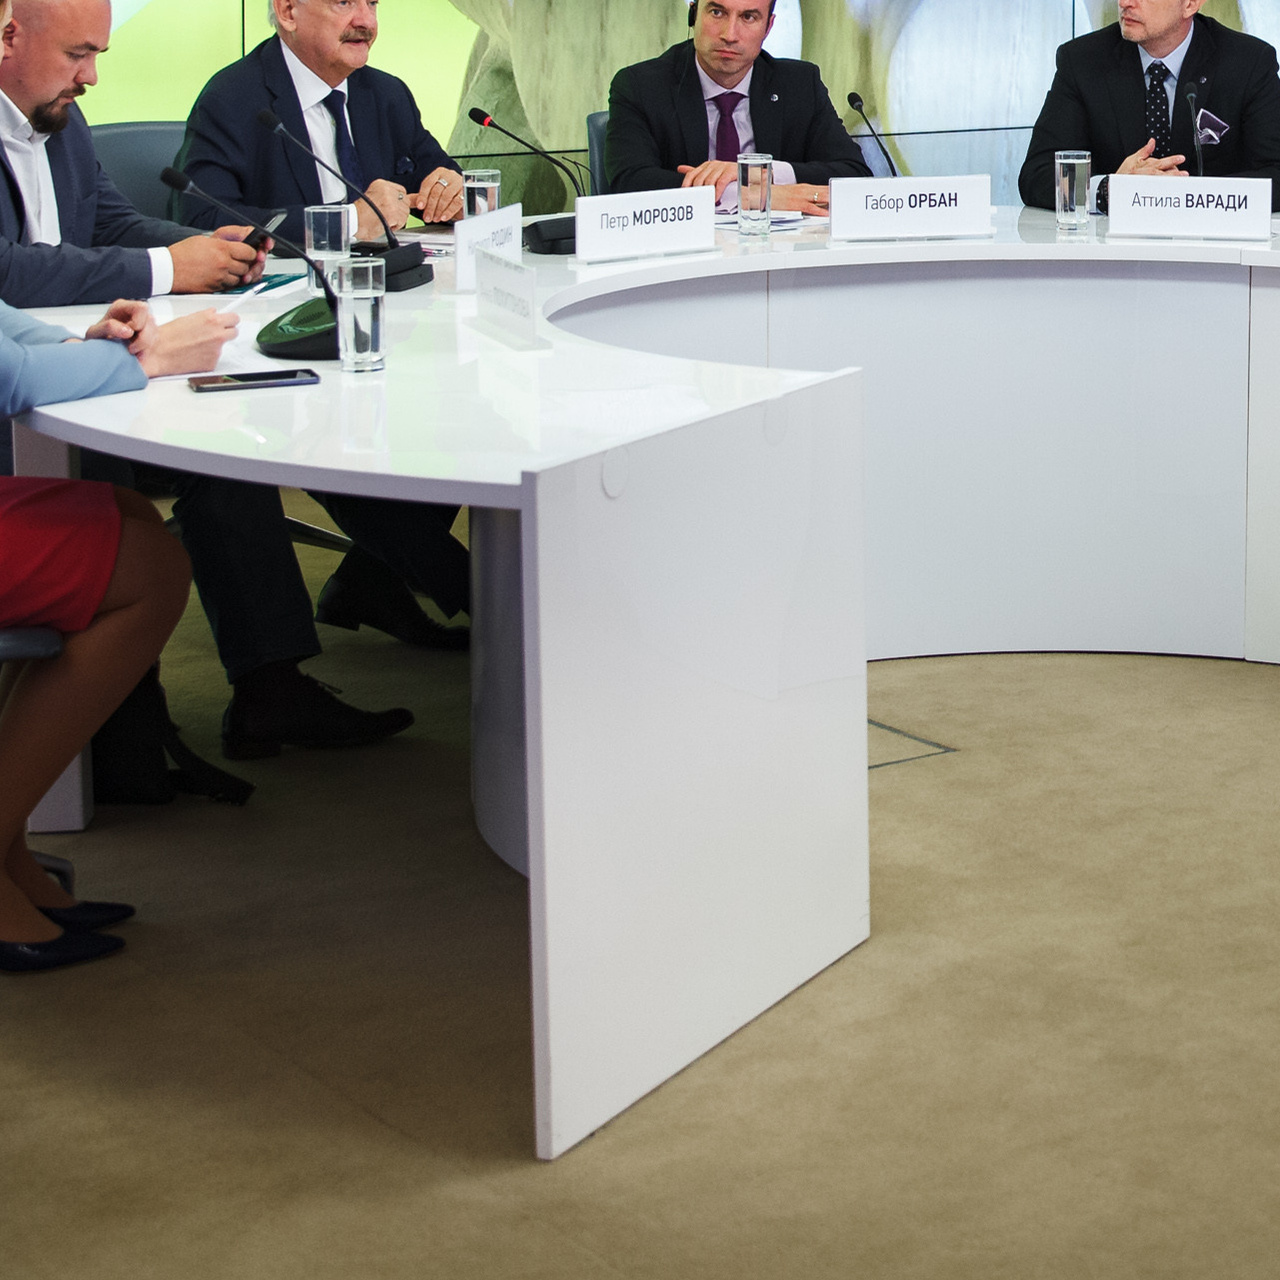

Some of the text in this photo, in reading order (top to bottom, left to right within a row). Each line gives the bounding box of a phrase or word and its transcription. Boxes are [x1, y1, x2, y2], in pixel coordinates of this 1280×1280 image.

[864, 192, 958, 214] Габор ОРБАН
[1131, 192, 1249, 212] Аттила ВАРАДИ
[601, 205, 693, 231] Петр МОРОЗОВ
